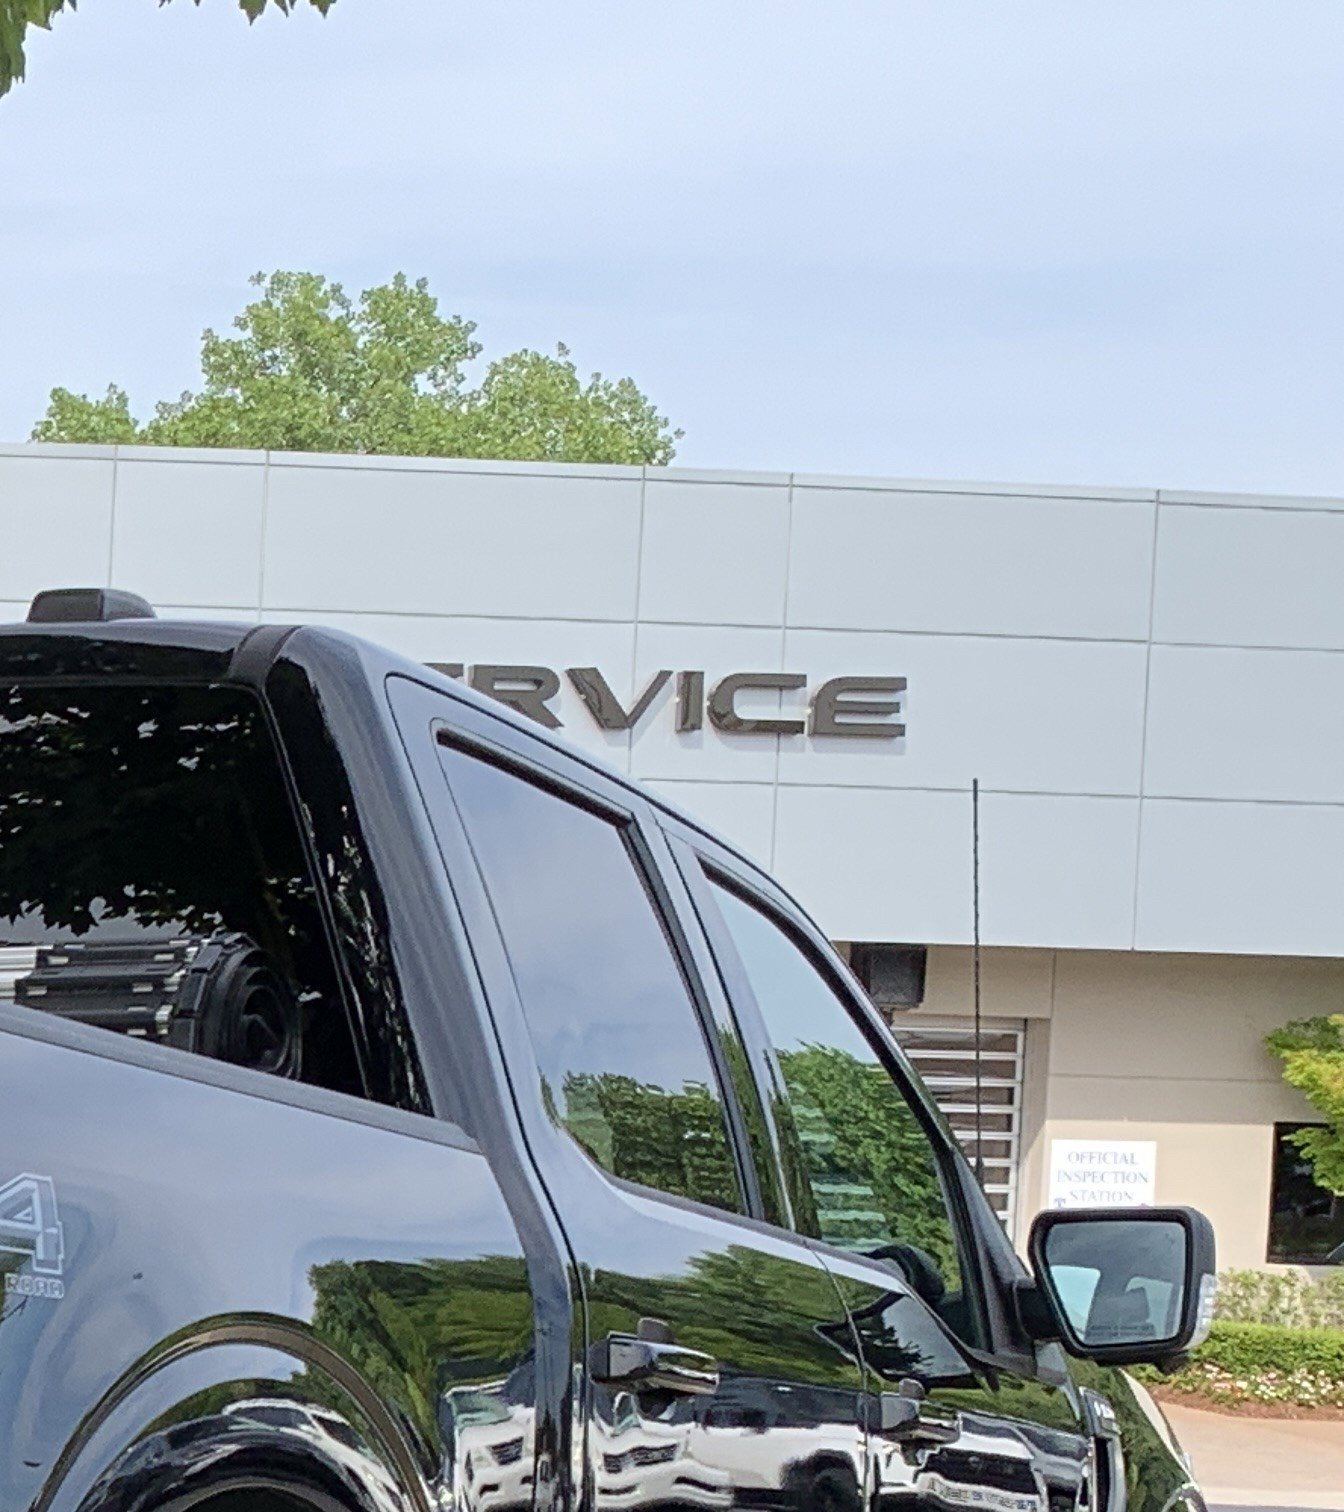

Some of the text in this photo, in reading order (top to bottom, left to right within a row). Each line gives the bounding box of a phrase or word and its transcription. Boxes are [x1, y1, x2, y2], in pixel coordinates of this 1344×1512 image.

[422, 662, 908, 739] RVICE
[1067, 1150, 1139, 1166] OFFICIAL
[1057, 1170, 1149, 1184] INSPECTION
[1069, 1188, 1135, 1202] STATION
[4, 1272, 65, 1300] ROAD
